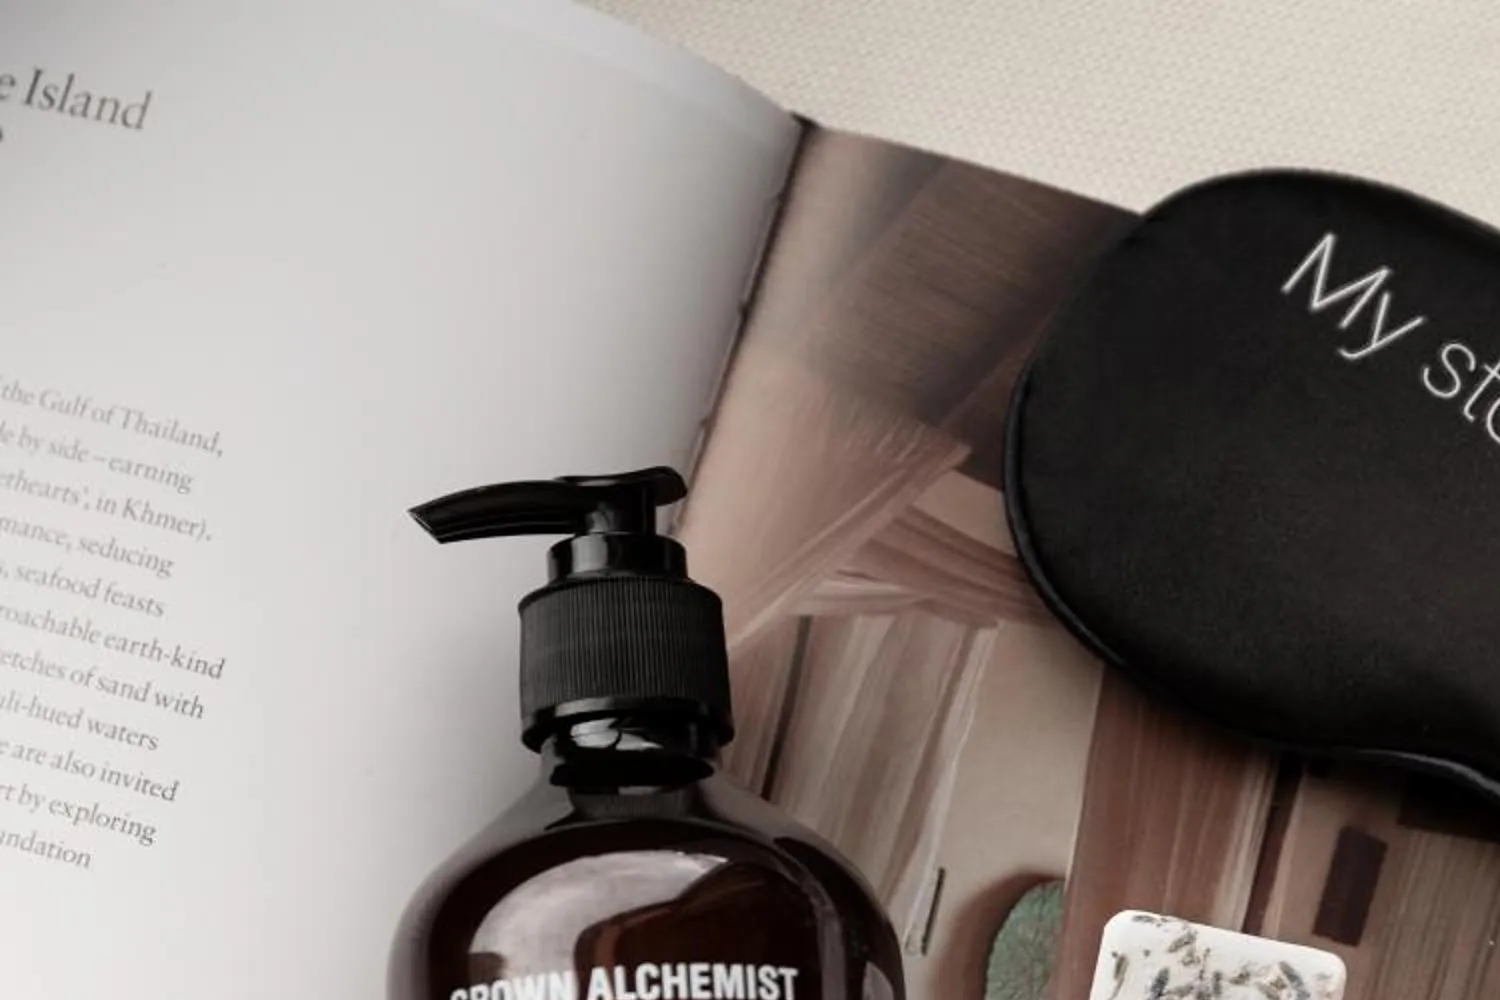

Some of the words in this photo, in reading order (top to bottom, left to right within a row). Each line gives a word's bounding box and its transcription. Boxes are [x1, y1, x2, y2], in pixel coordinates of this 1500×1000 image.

[24, 66, 152, 130] Island
[1281, 233, 1425, 360] My
[2, 379, 36, 405] the
[38, 388, 90, 419] Gulf
[91, 403, 117, 426] of
[117, 405, 224, 458] Thailand,
[17, 424, 43, 456] by
[95, 495, 118, 516] in
[121, 496, 213, 542] Khmer).
[78, 535, 175, 579] seducing
[16, 562, 103, 601] seafood
[103, 580, 165, 618] feasts
[103, 633, 226, 681] earth-kind
[69, 666, 97, 688] of
[97, 674, 152, 704] sand
[154, 690, 205, 720] with
[86, 718, 160, 752] waters
[12, 741, 48, 766] are
[49, 750, 96, 779] also
[100, 761, 180, 802] invited
[18, 783, 46, 815] by
[48, 797, 158, 848] exploring
